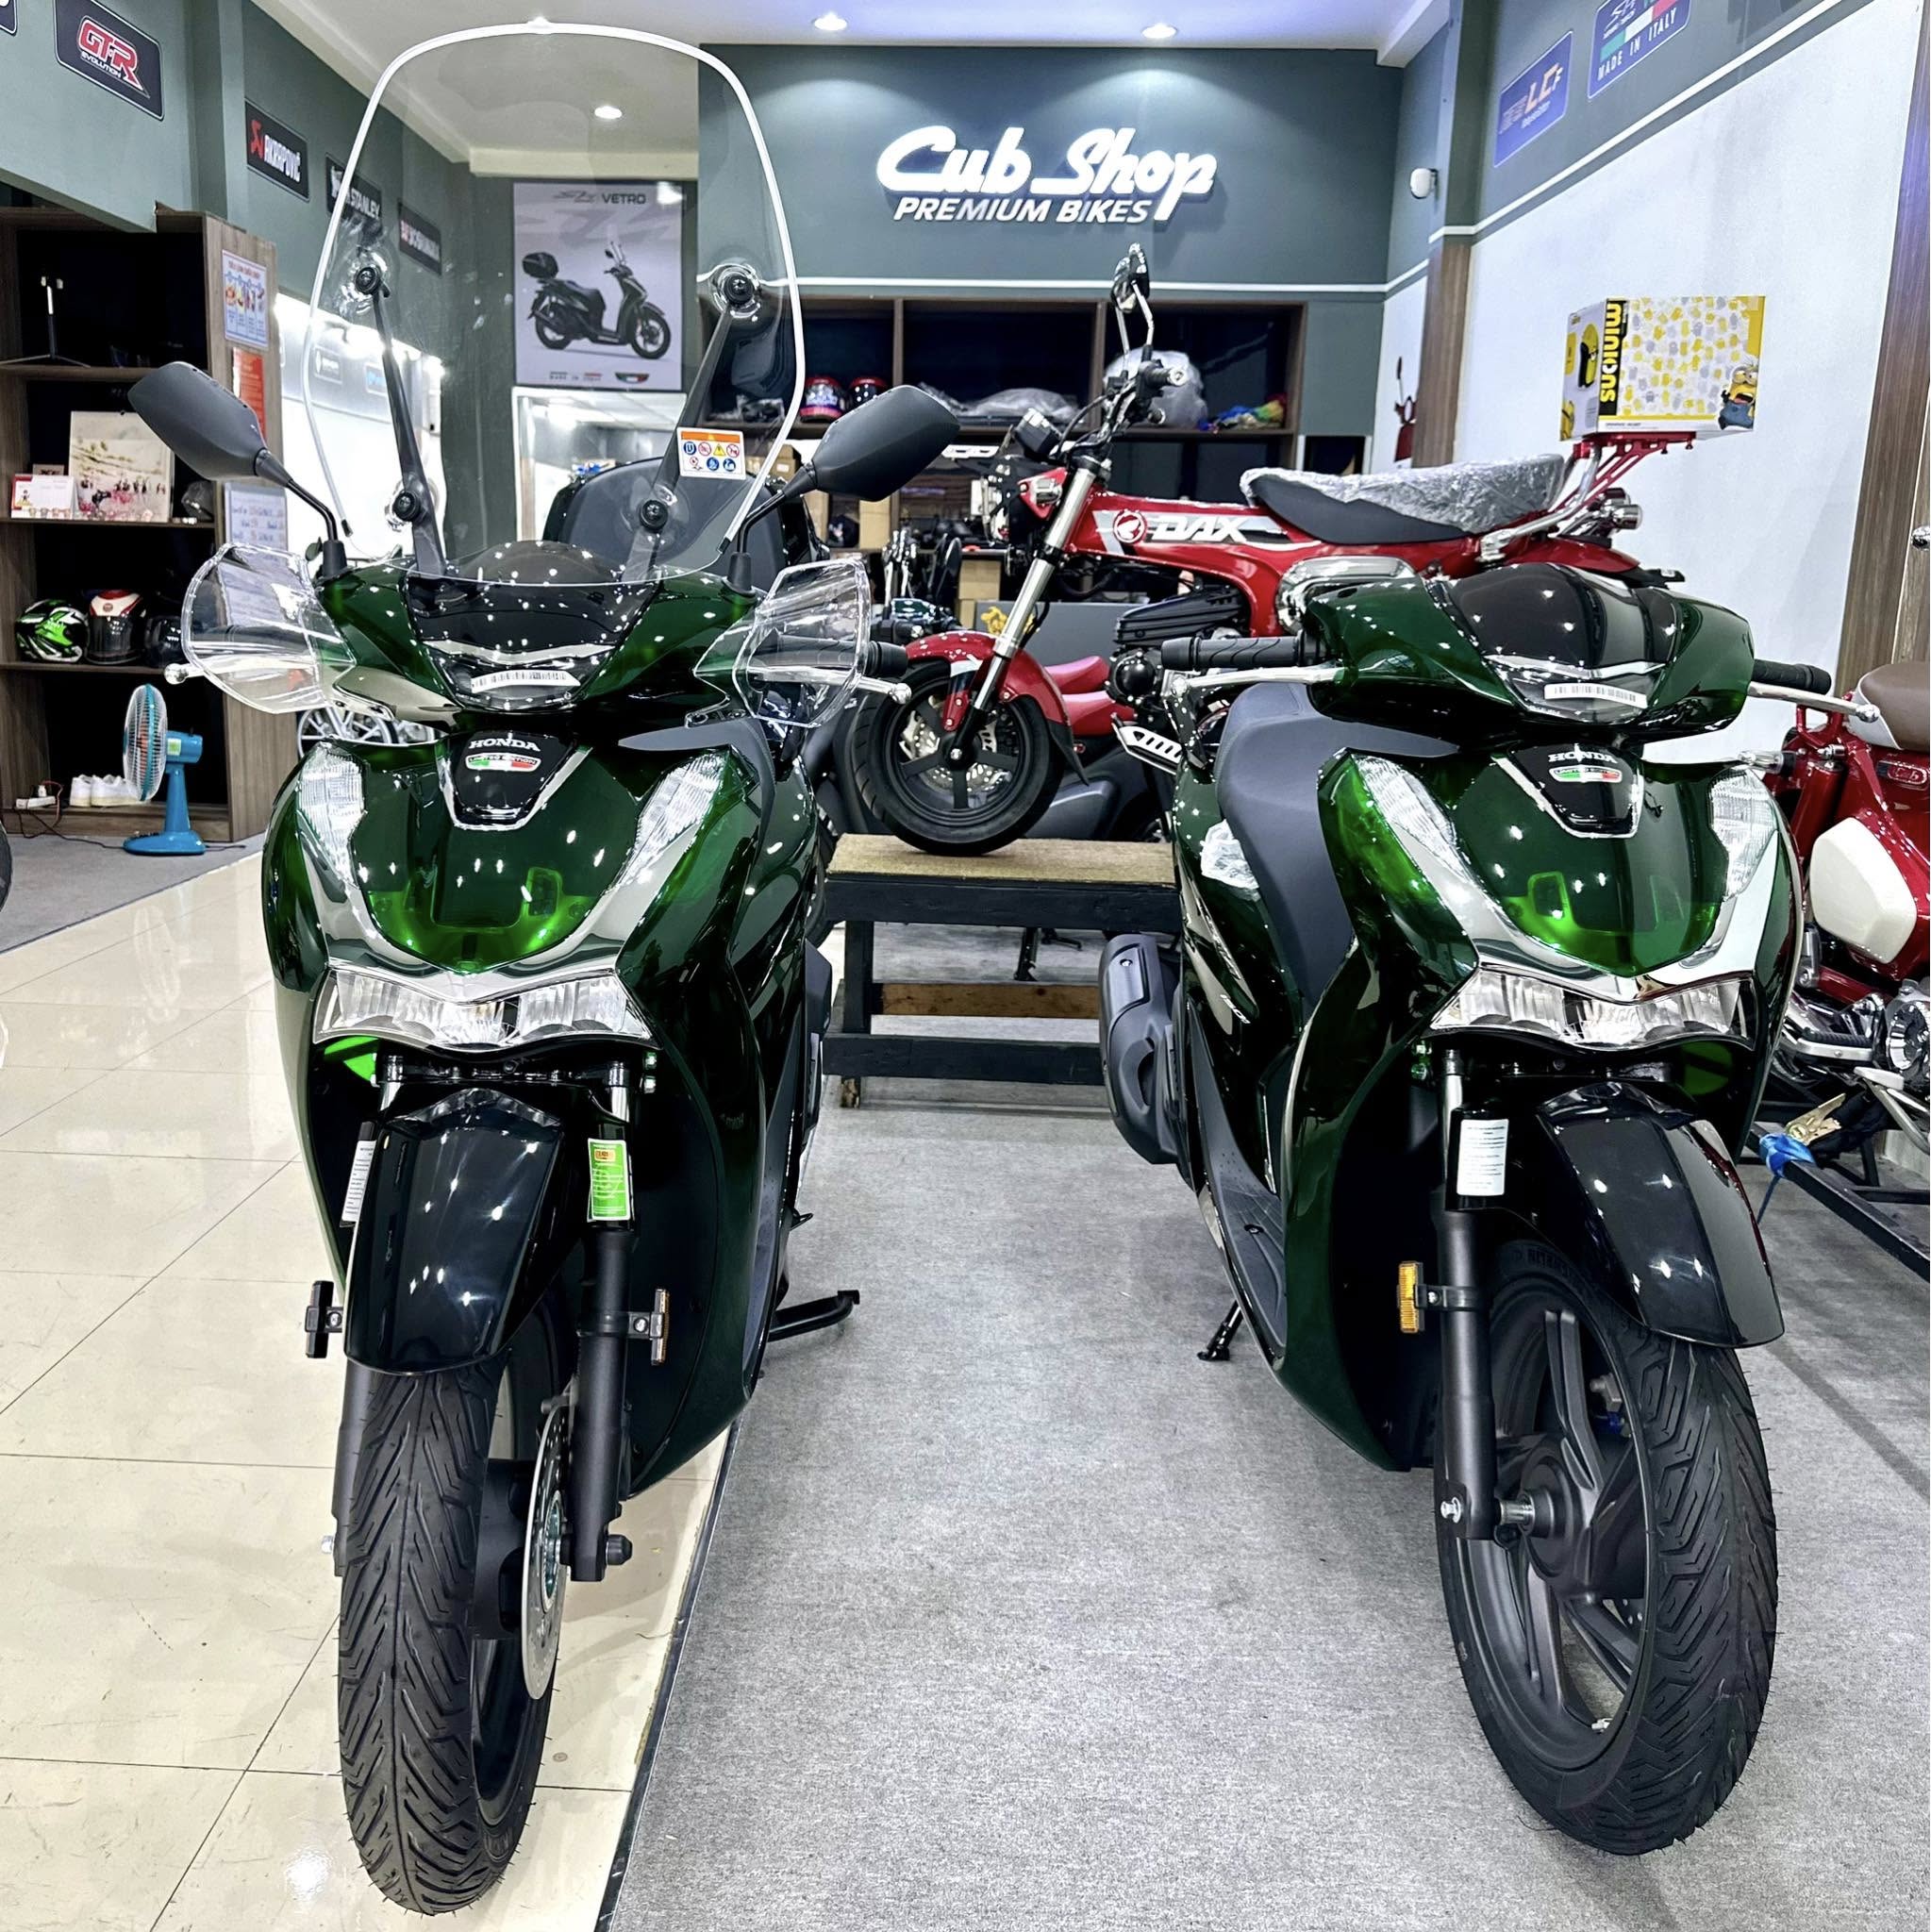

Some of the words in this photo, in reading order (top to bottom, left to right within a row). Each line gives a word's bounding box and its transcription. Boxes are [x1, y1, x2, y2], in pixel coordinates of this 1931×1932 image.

[78, 19, 144, 92] GTR
[1598, 50, 1623, 81] MADE
[1629, 36, 1641, 57] IN
[1648, 7, 1677, 42] ITALY
[81, 51, 123, 78] EVOLUTION
[875, 125, 1033, 194] Cub
[1030, 126, 1218, 222] Shop
[601, 192, 647, 205] VETRO
[893, 197, 1048, 223] PREMIUM
[1056, 199, 1153, 224] BIKES
[1150, 518, 1248, 542] DAX
[468, 738, 541, 752] HONDA
[1547, 751, 1619, 764] HONDA
